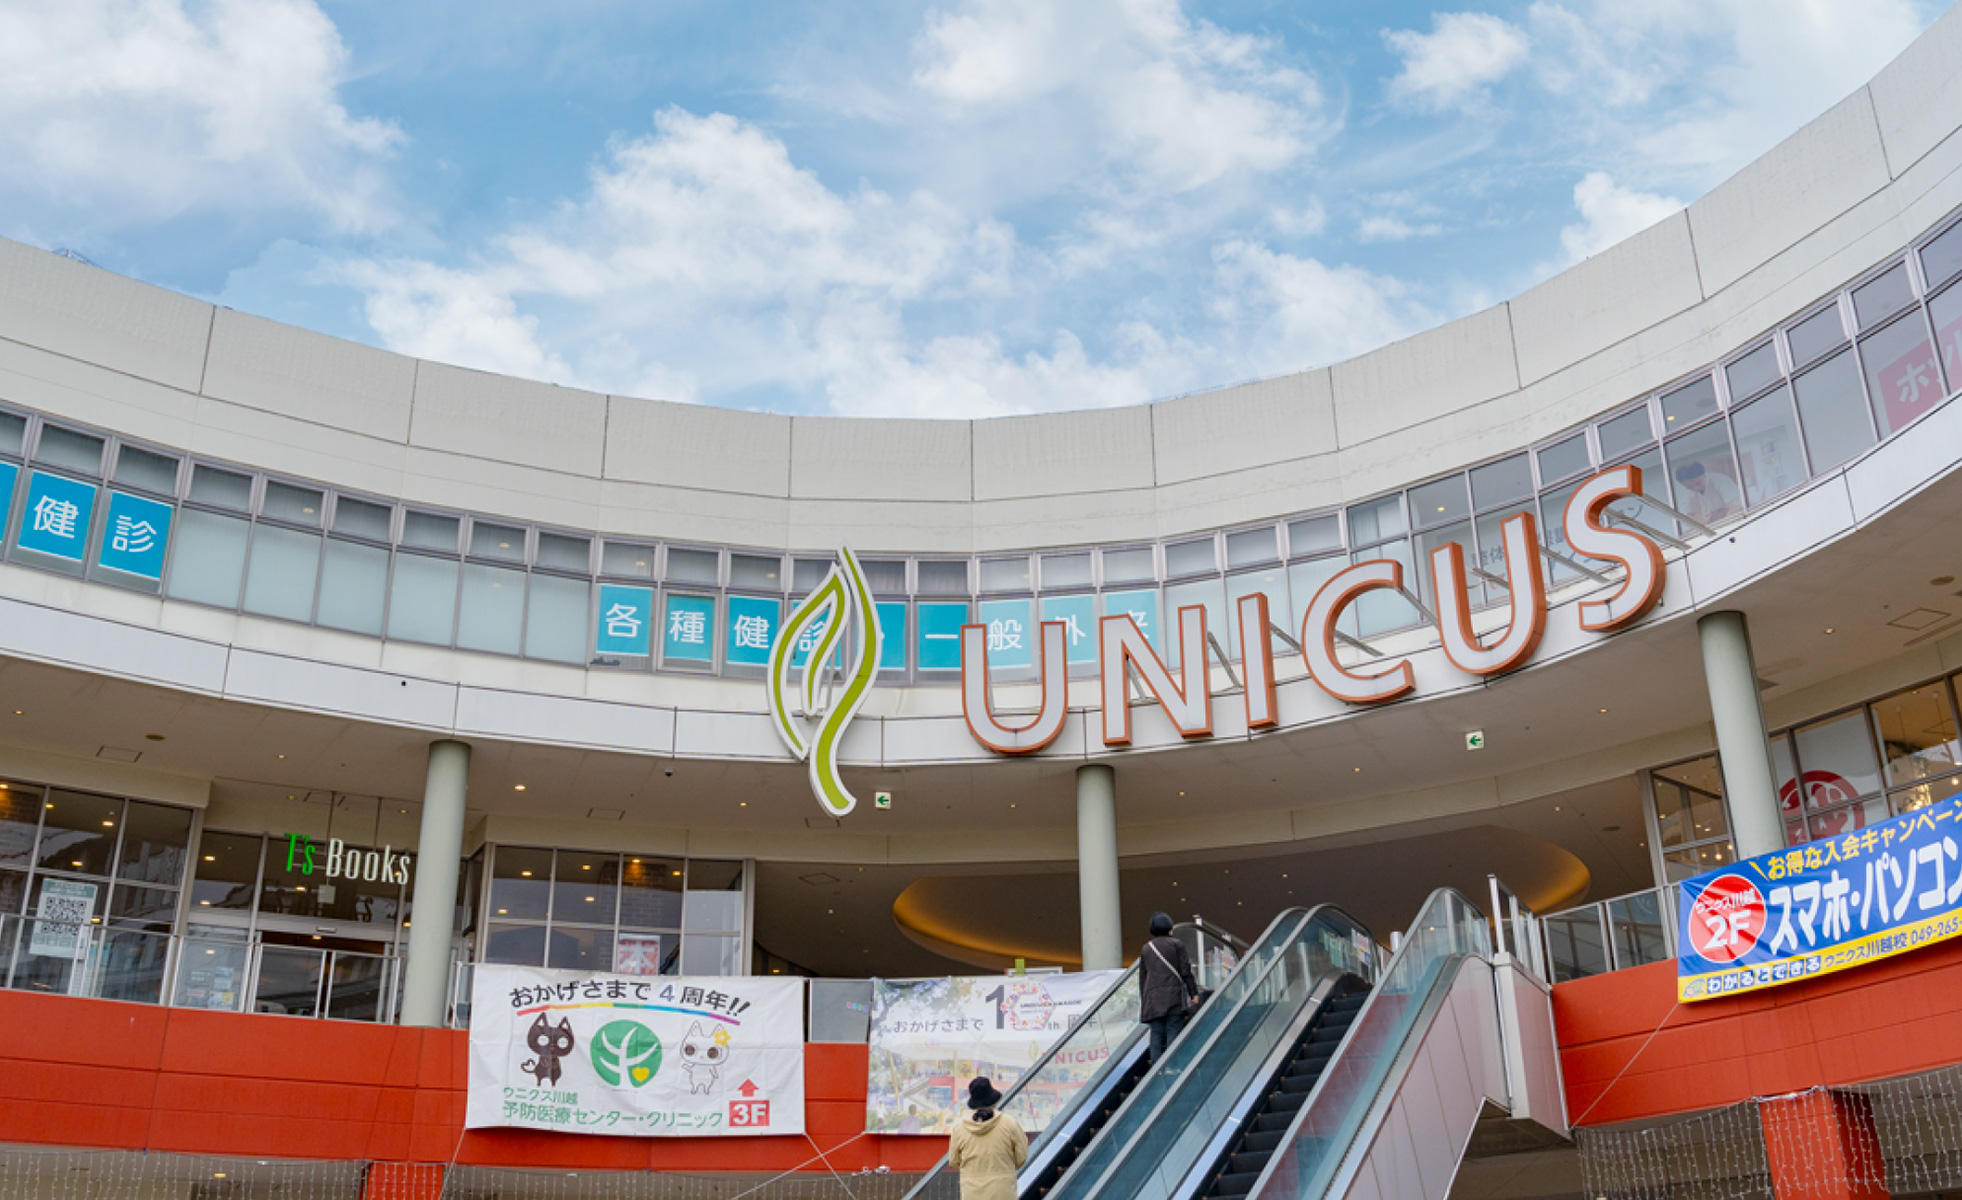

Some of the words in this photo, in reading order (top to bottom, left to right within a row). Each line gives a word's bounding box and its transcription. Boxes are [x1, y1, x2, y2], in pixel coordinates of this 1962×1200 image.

[33, 494, 158, 553] 健診
[961, 465, 1666, 755] UNICUS
[284, 832, 316, 875] T's
[326, 837, 411, 886] Books
[1703, 909, 1752, 950] 2F
[1825, 932, 1908, 968] ウニクス川越校
[1707, 955, 1821, 994] わかるとできる
[893, 1017, 985, 1034] おかげさまで
[1042, 1046, 1110, 1066] NICUS
[502, 1086, 579, 1106] ウニクス川越
[502, 1101, 723, 1129] 予防医療センター・クリニック
[732, 1103, 767, 1126] 3F
